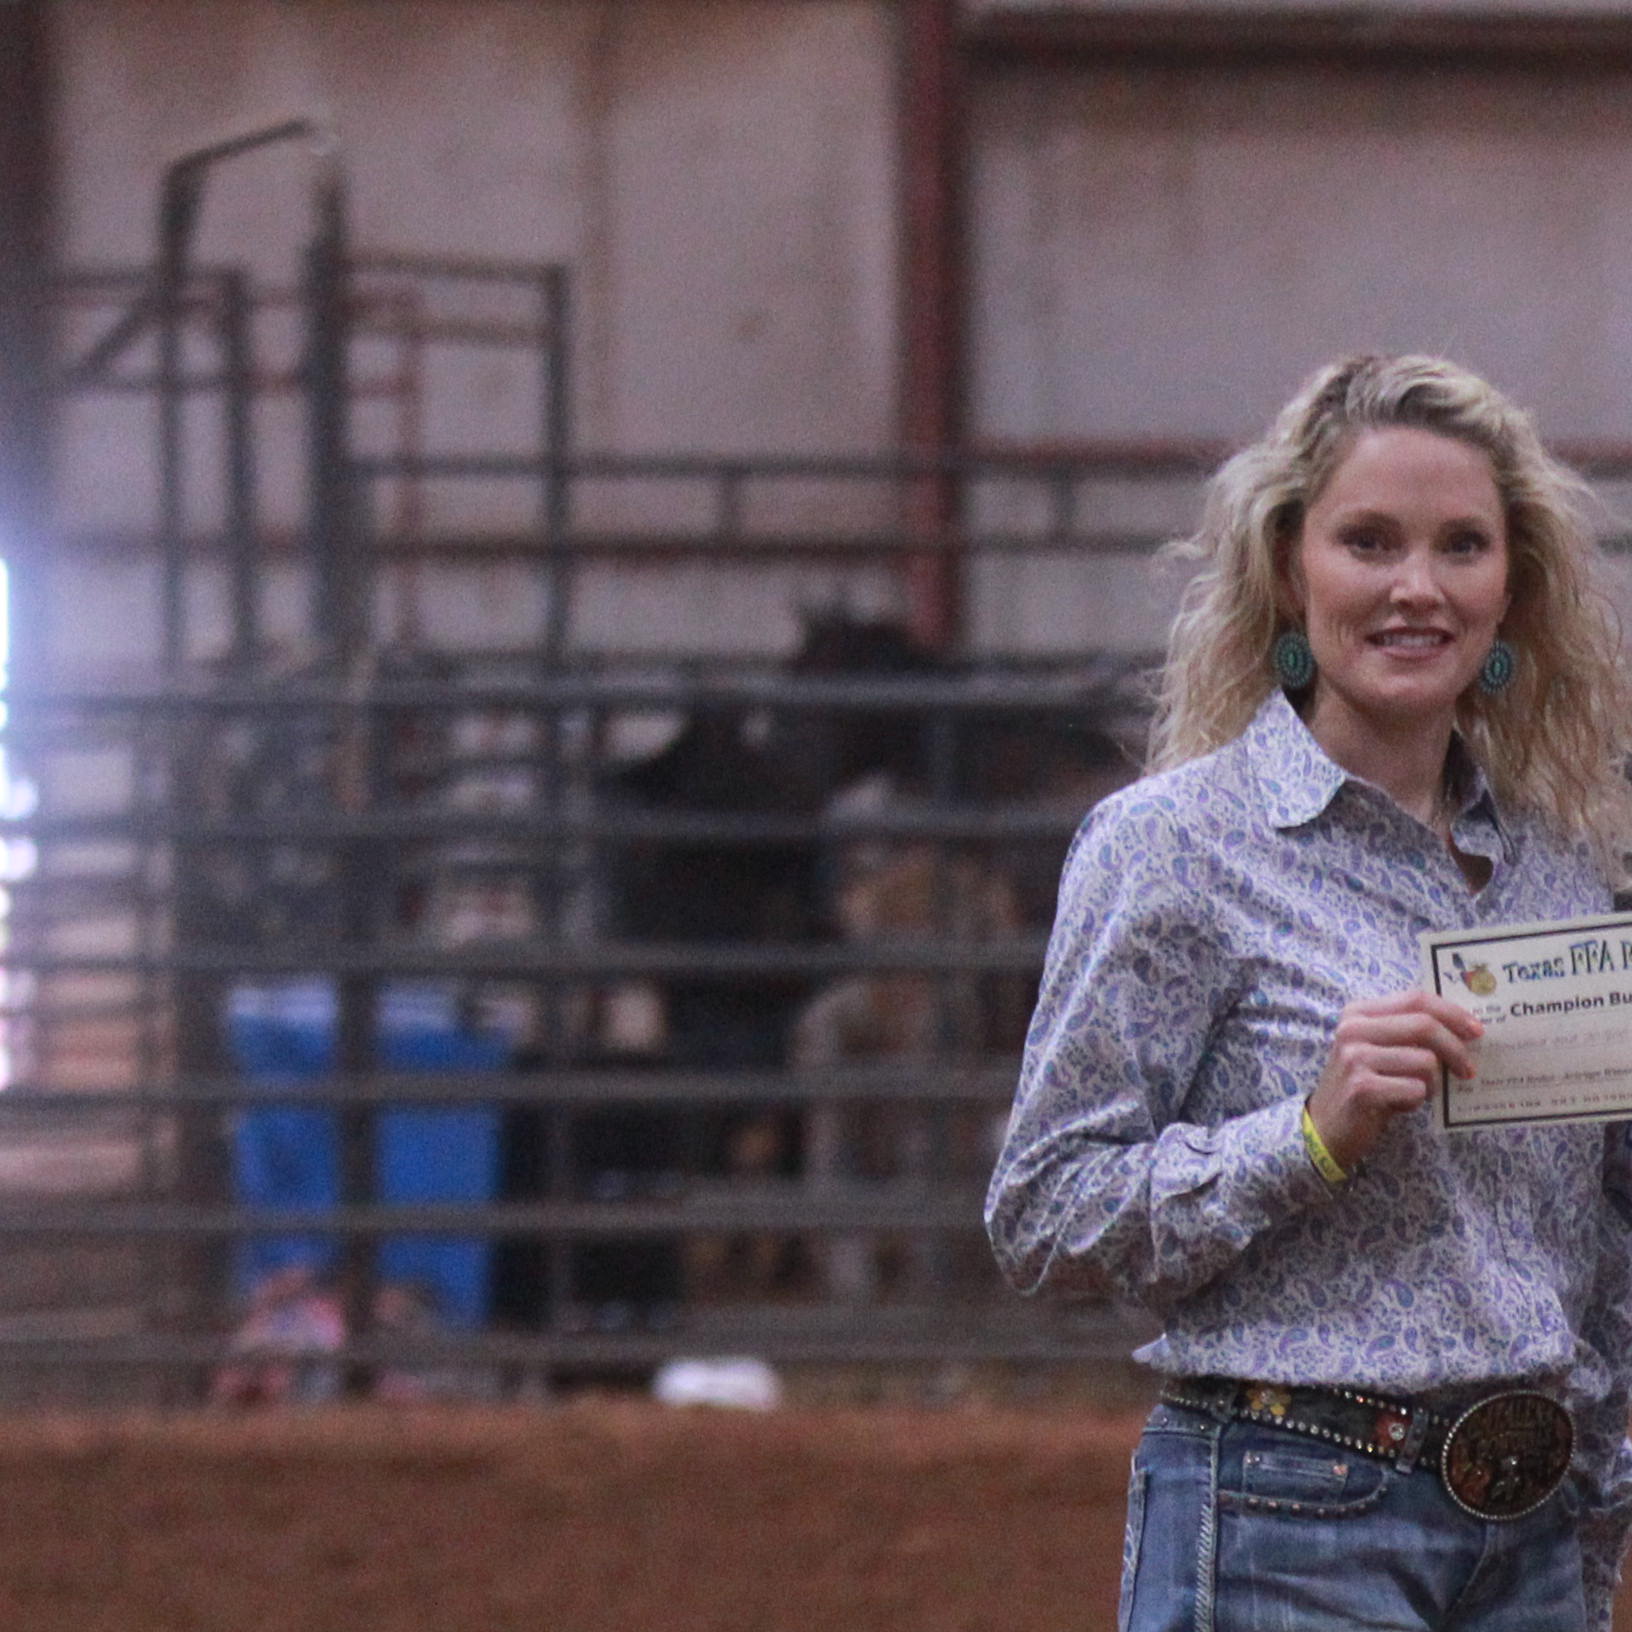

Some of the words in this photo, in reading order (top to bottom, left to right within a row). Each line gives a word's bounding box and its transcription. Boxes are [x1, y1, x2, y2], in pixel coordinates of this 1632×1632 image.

[1503, 957, 1565, 983] Texas
[1569, 940, 1615, 976] FFA
[1510, 995, 1604, 1017] Champion
